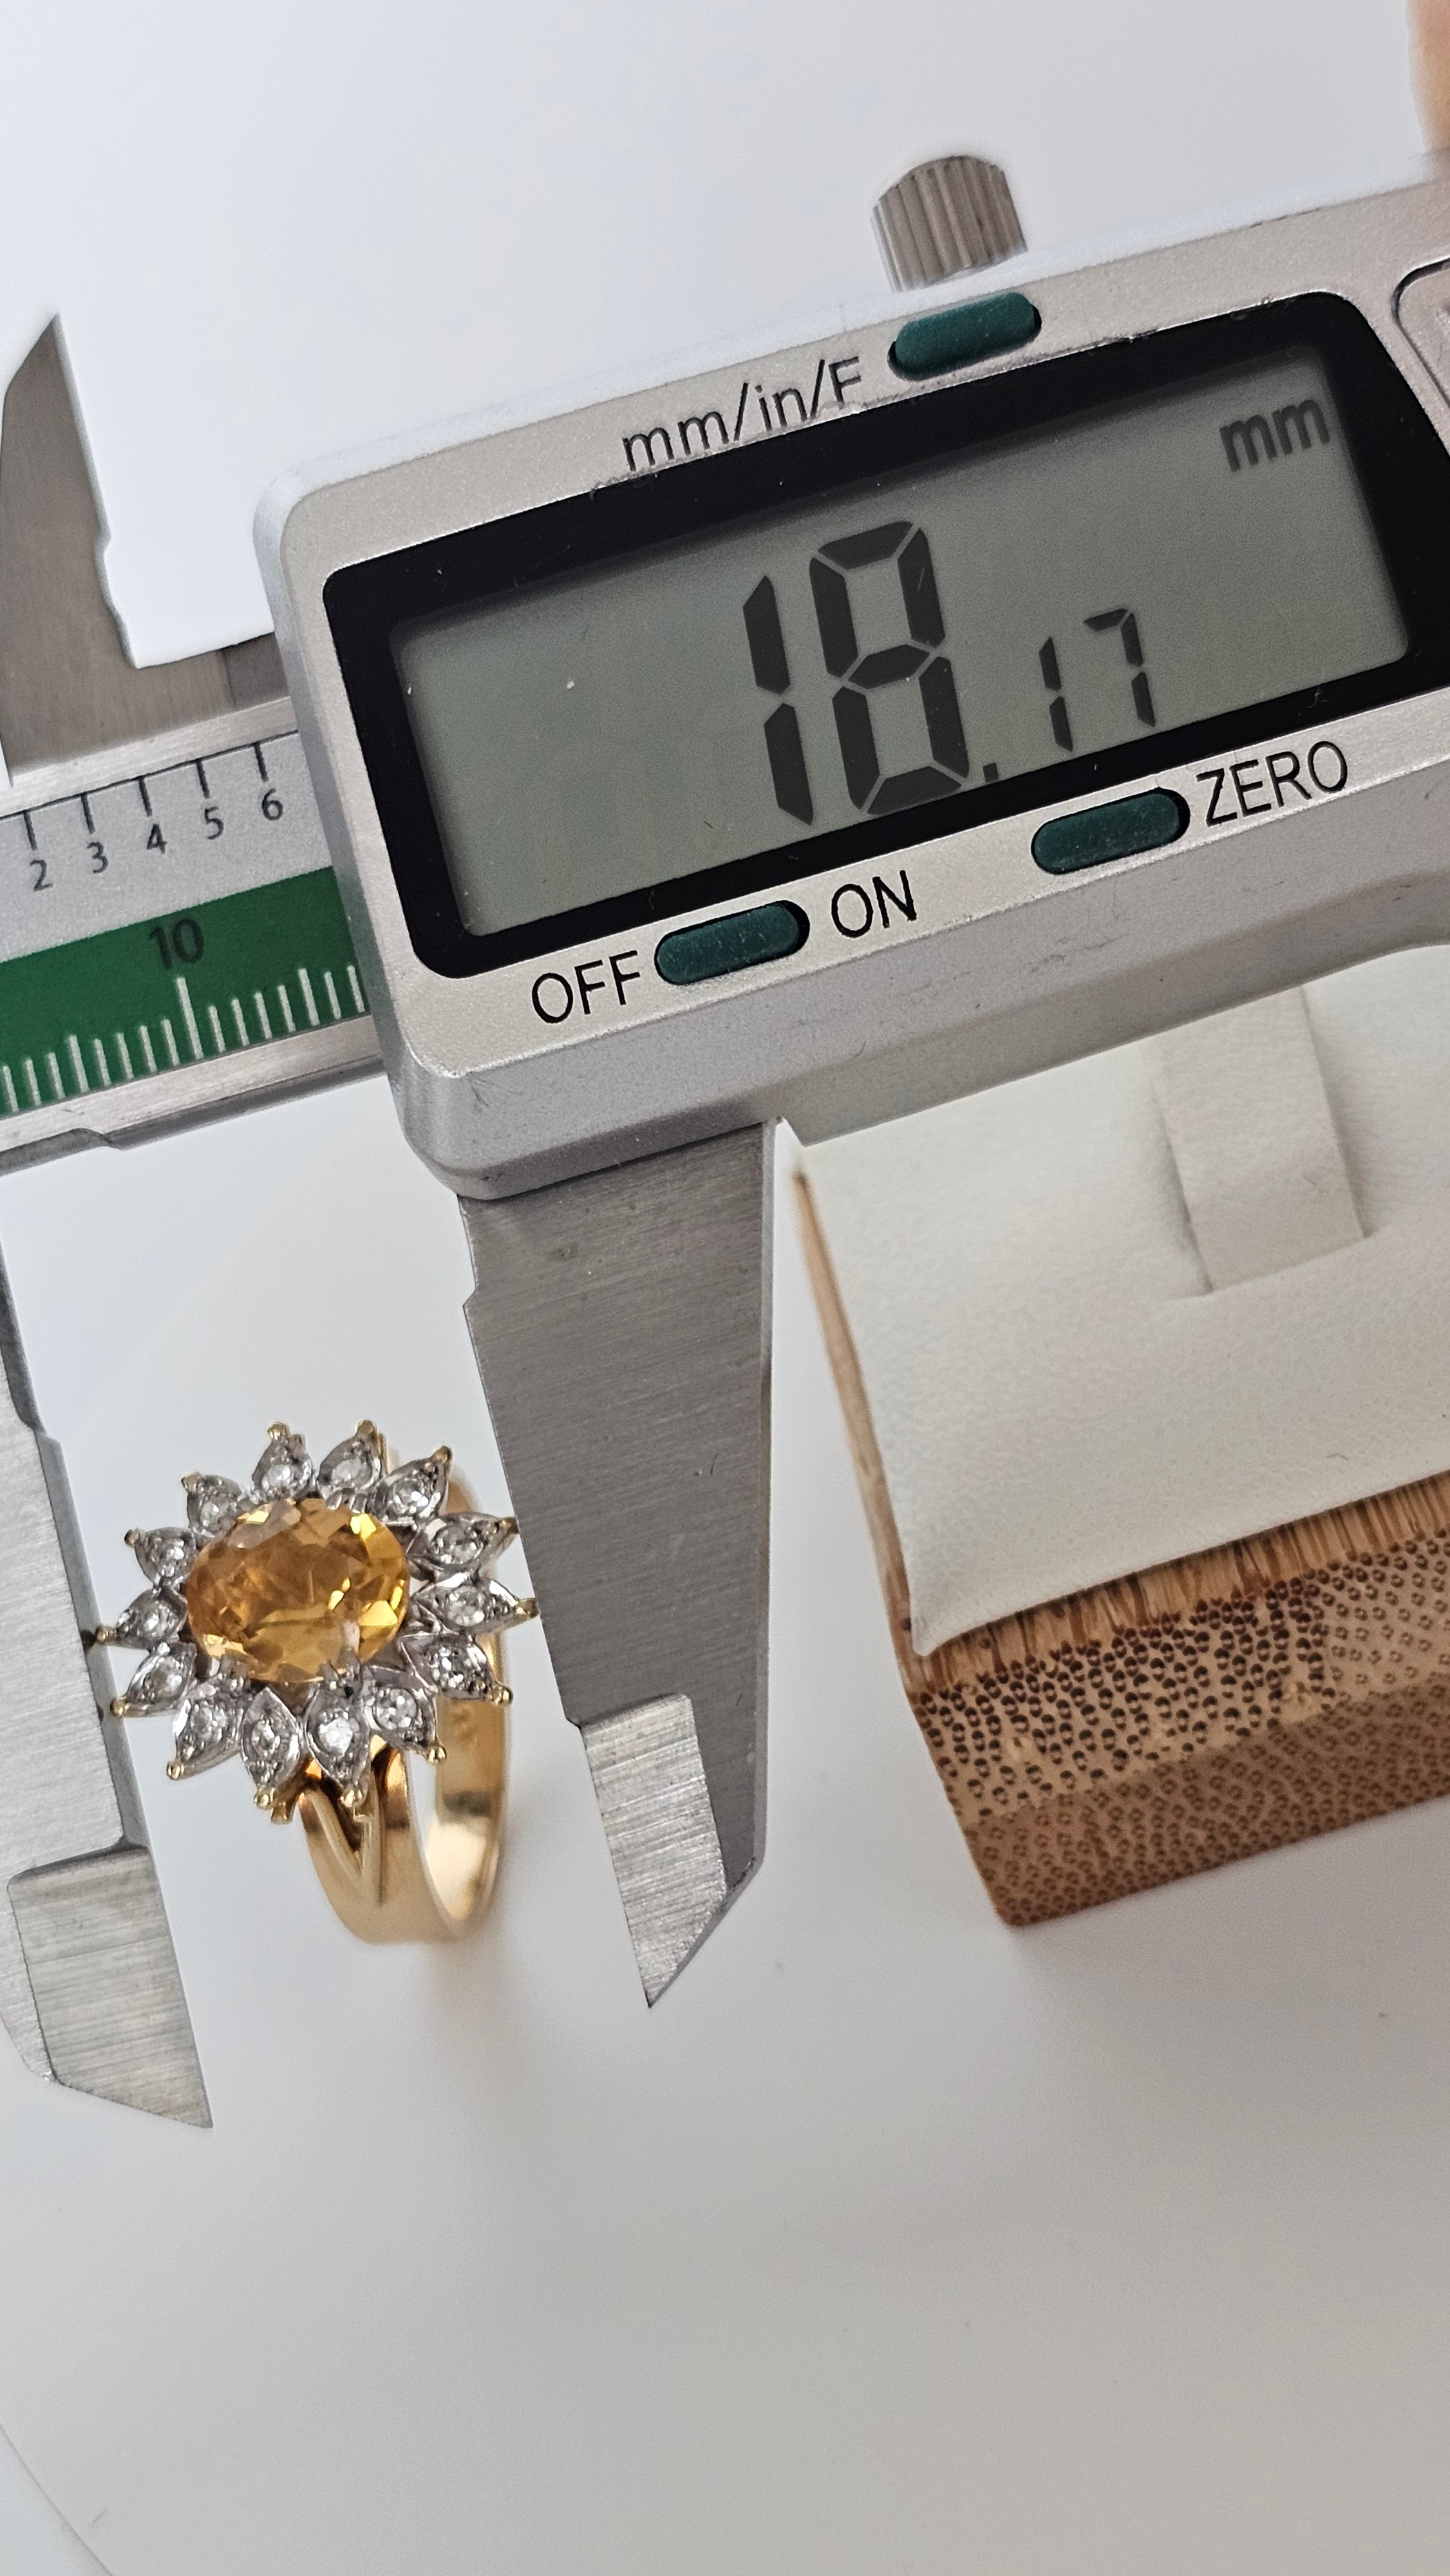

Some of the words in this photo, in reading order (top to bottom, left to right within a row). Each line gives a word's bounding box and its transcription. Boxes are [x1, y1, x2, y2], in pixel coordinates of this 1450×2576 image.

[622, 356, 862, 471] mm/in/F
[1219, 397, 1331, 472] mm
[742, 521, 1156, 826] 18.17
[1196, 740, 1348, 827] ZERO
[30, 860, 53, 891] 2
[87, 842, 109, 874] 3
[146, 824, 166, 855] 4
[203, 806, 224, 840] 5
[261, 788, 283, 821] 6
[149, 918, 205, 967] 10
[831, 869, 918, 938] ON
[531, 950, 641, 1024] OFF
